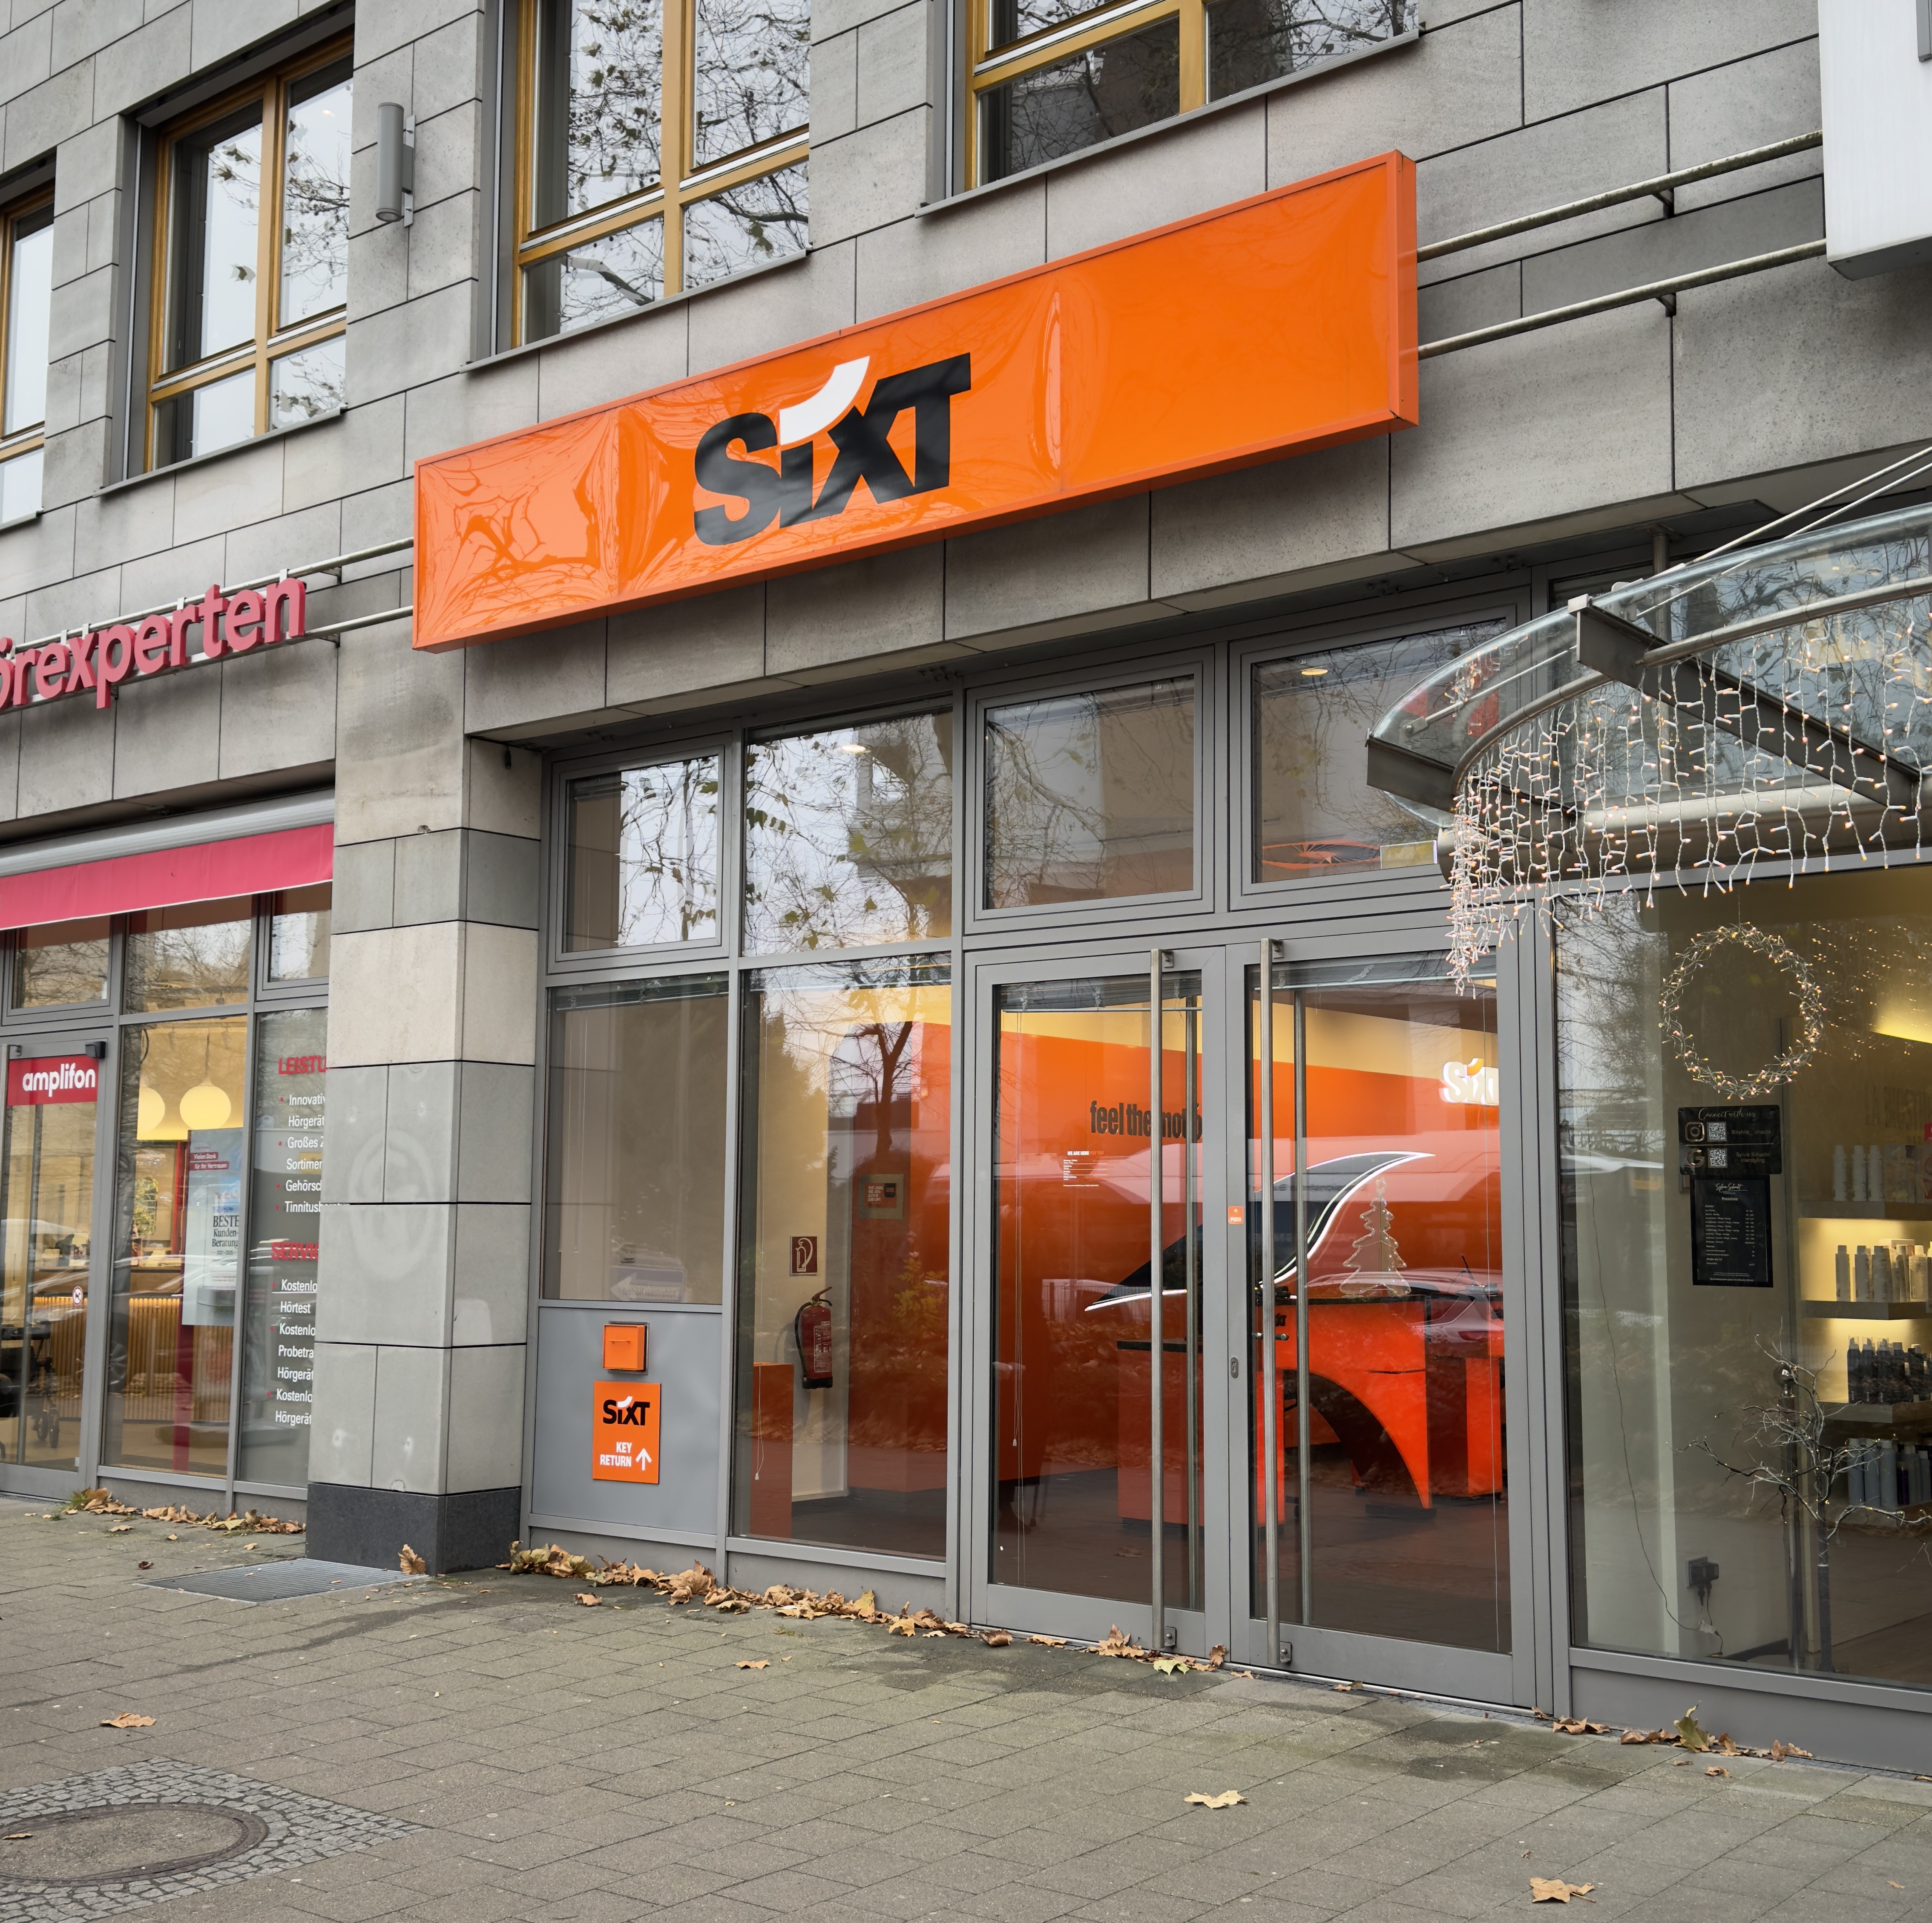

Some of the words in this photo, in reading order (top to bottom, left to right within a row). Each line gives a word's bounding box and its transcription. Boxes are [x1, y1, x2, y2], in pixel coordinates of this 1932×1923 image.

[23, 1063, 95, 1097] amplifon
[1090, 1100, 1124, 1135] feel
[1126, 1103, 1151, 1137] the
[288, 1136, 318, 1149] Großes
[213, 1215, 239, 1227] BESTE
[213, 1228, 238, 1237] Kunden-
[212, 1238, 239, 1248] Beratung
[282, 1279, 317, 1291] Kostenlo
[280, 1301, 311, 1313] Hörtest
[279, 1323, 316, 1336] Kostenlo
[278, 1344, 314, 1358] Probetra
[276, 1388, 312, 1402] Kostenlo
[616, 1442, 632, 1453] KEY
[600, 1454, 632, 1467] RETURN
